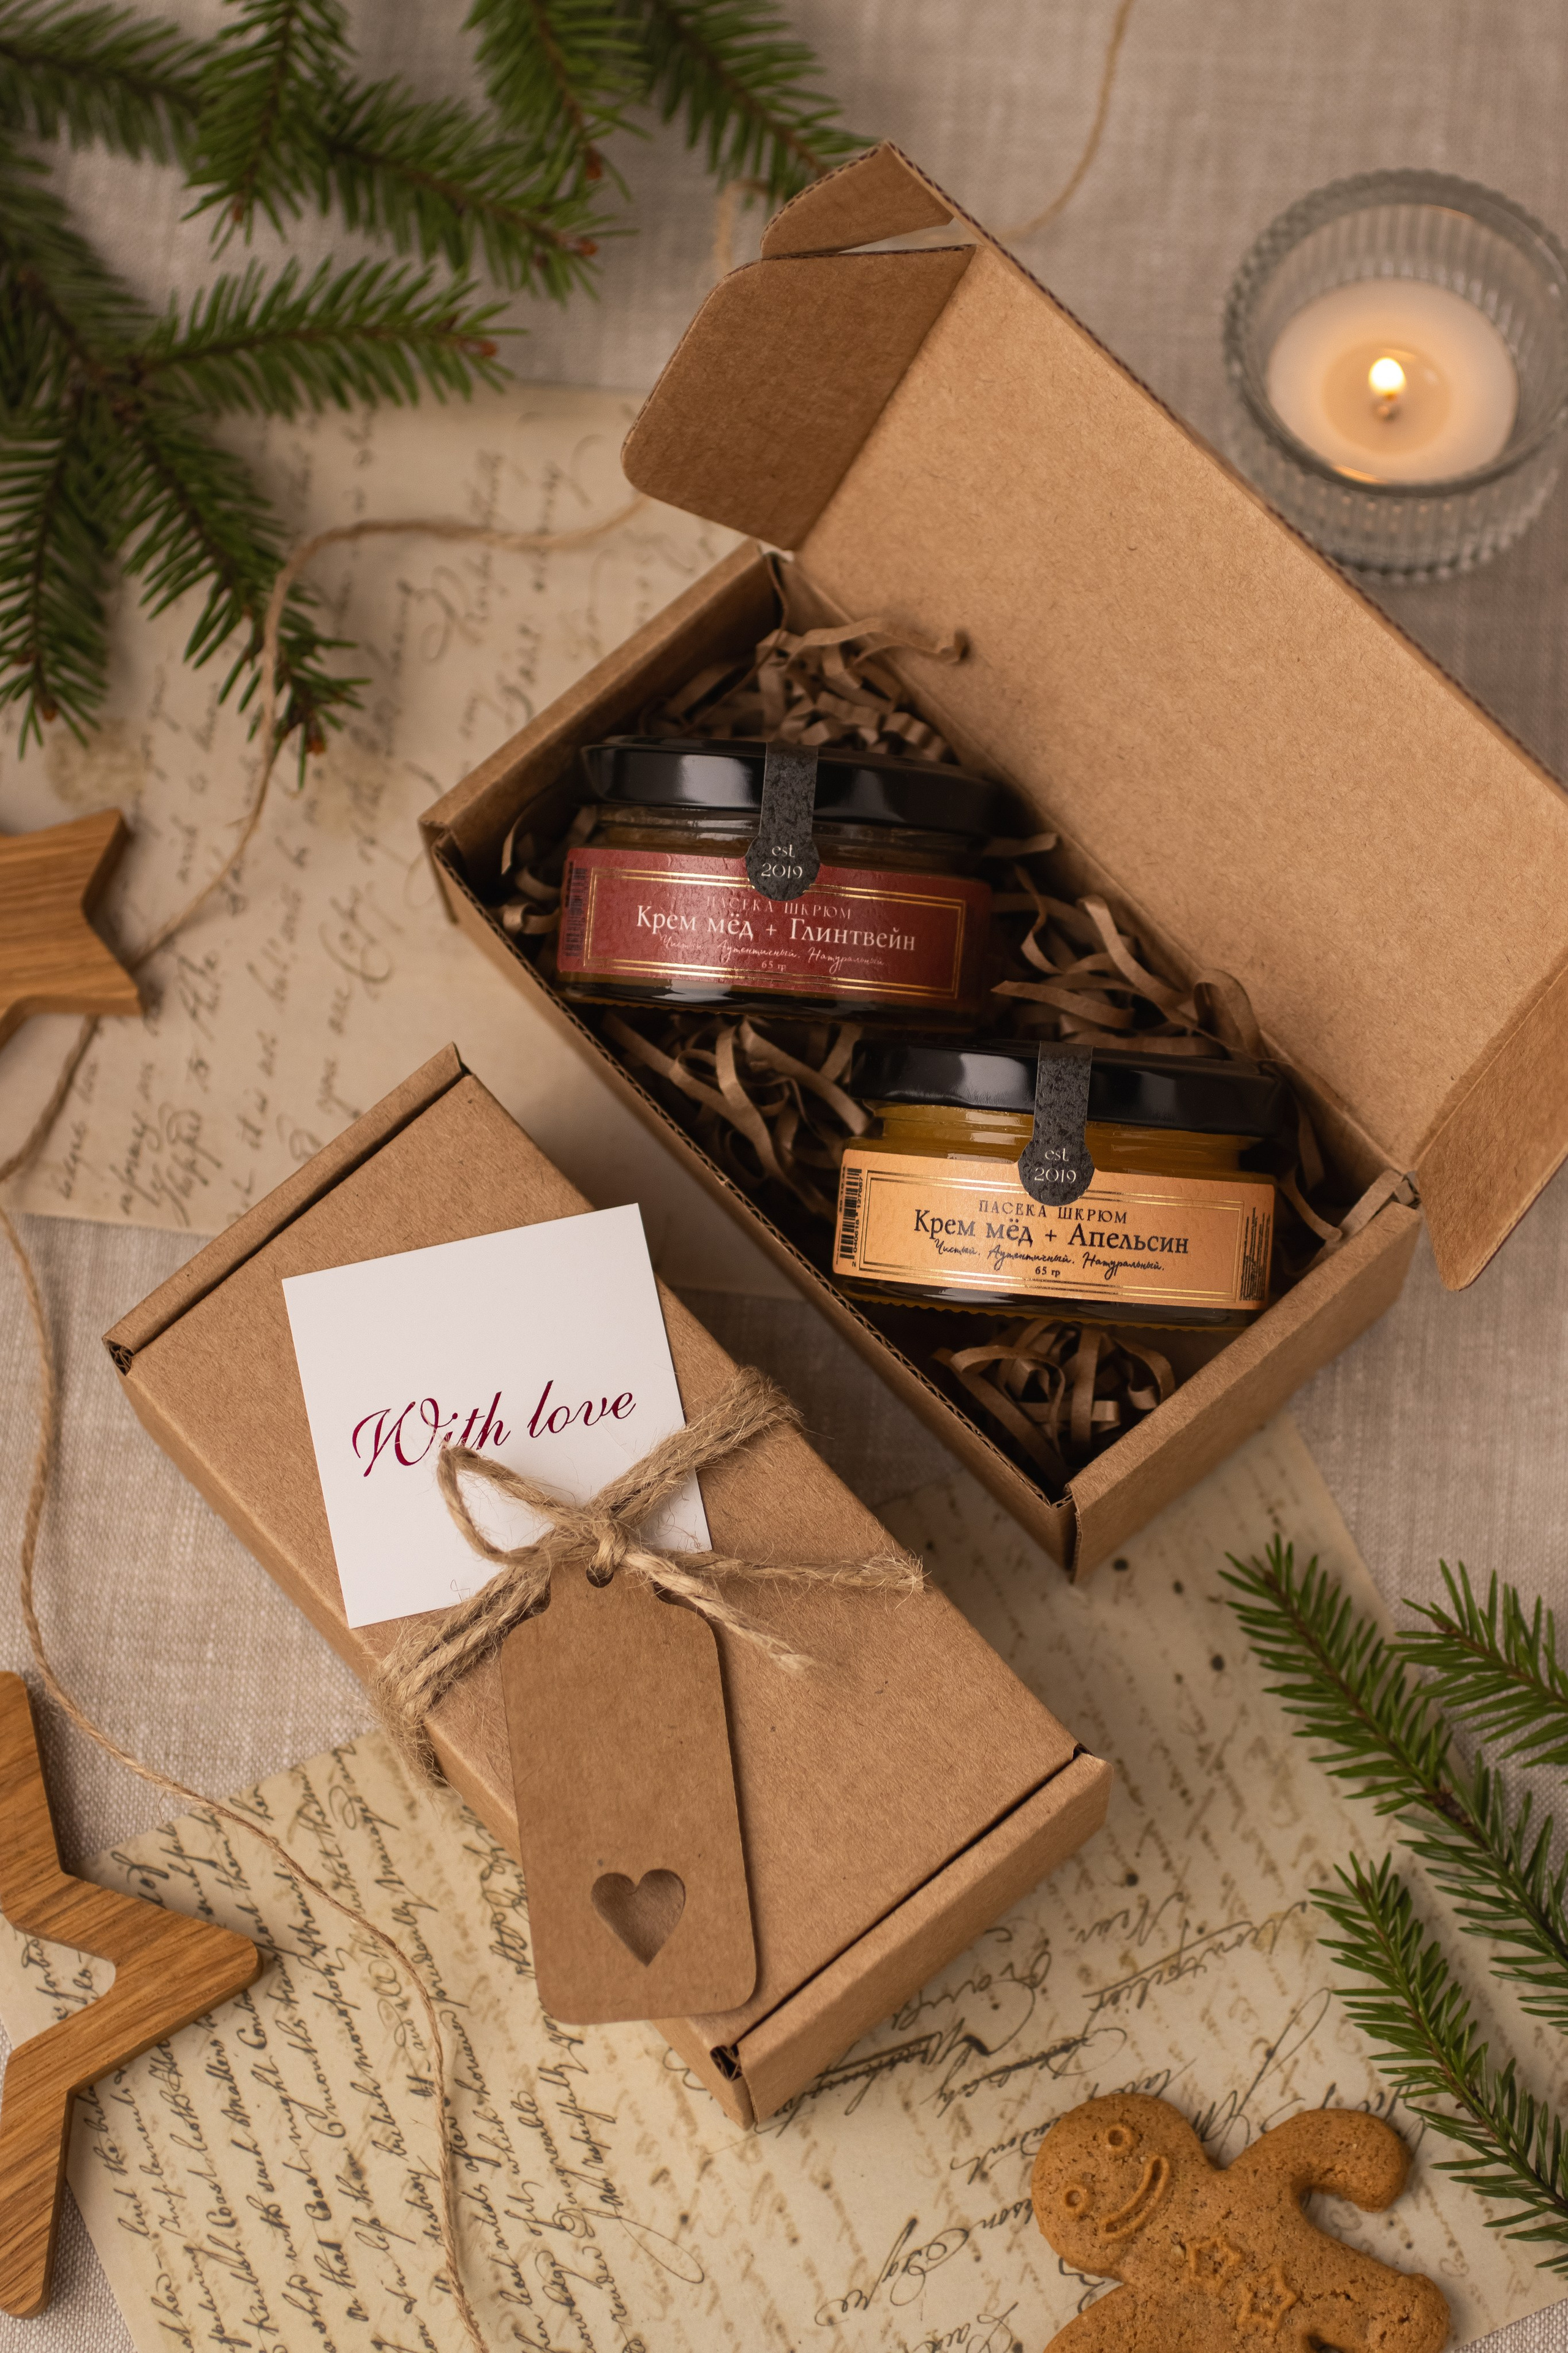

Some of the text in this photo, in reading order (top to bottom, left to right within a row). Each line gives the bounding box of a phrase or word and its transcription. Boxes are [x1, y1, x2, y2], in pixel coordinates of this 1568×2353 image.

[771, 844, 795, 857] est
[761, 863, 803, 880] 2019
[784, 902, 851, 919] ШКРЮМ
[636, 905, 916, 951] Крем мёд + Глинтвейн
[1045, 1147, 1069, 1162] est
[1034, 1167, 1077, 1184] 2019
[979, 1200, 1128, 1224] ПАСЕКА ШКРЮМ
[913, 1209, 1188, 1254] Крем мёд + Апельсин
[1035, 1266, 1047, 1275] 65
[352, 1380, 636, 1478] With love
